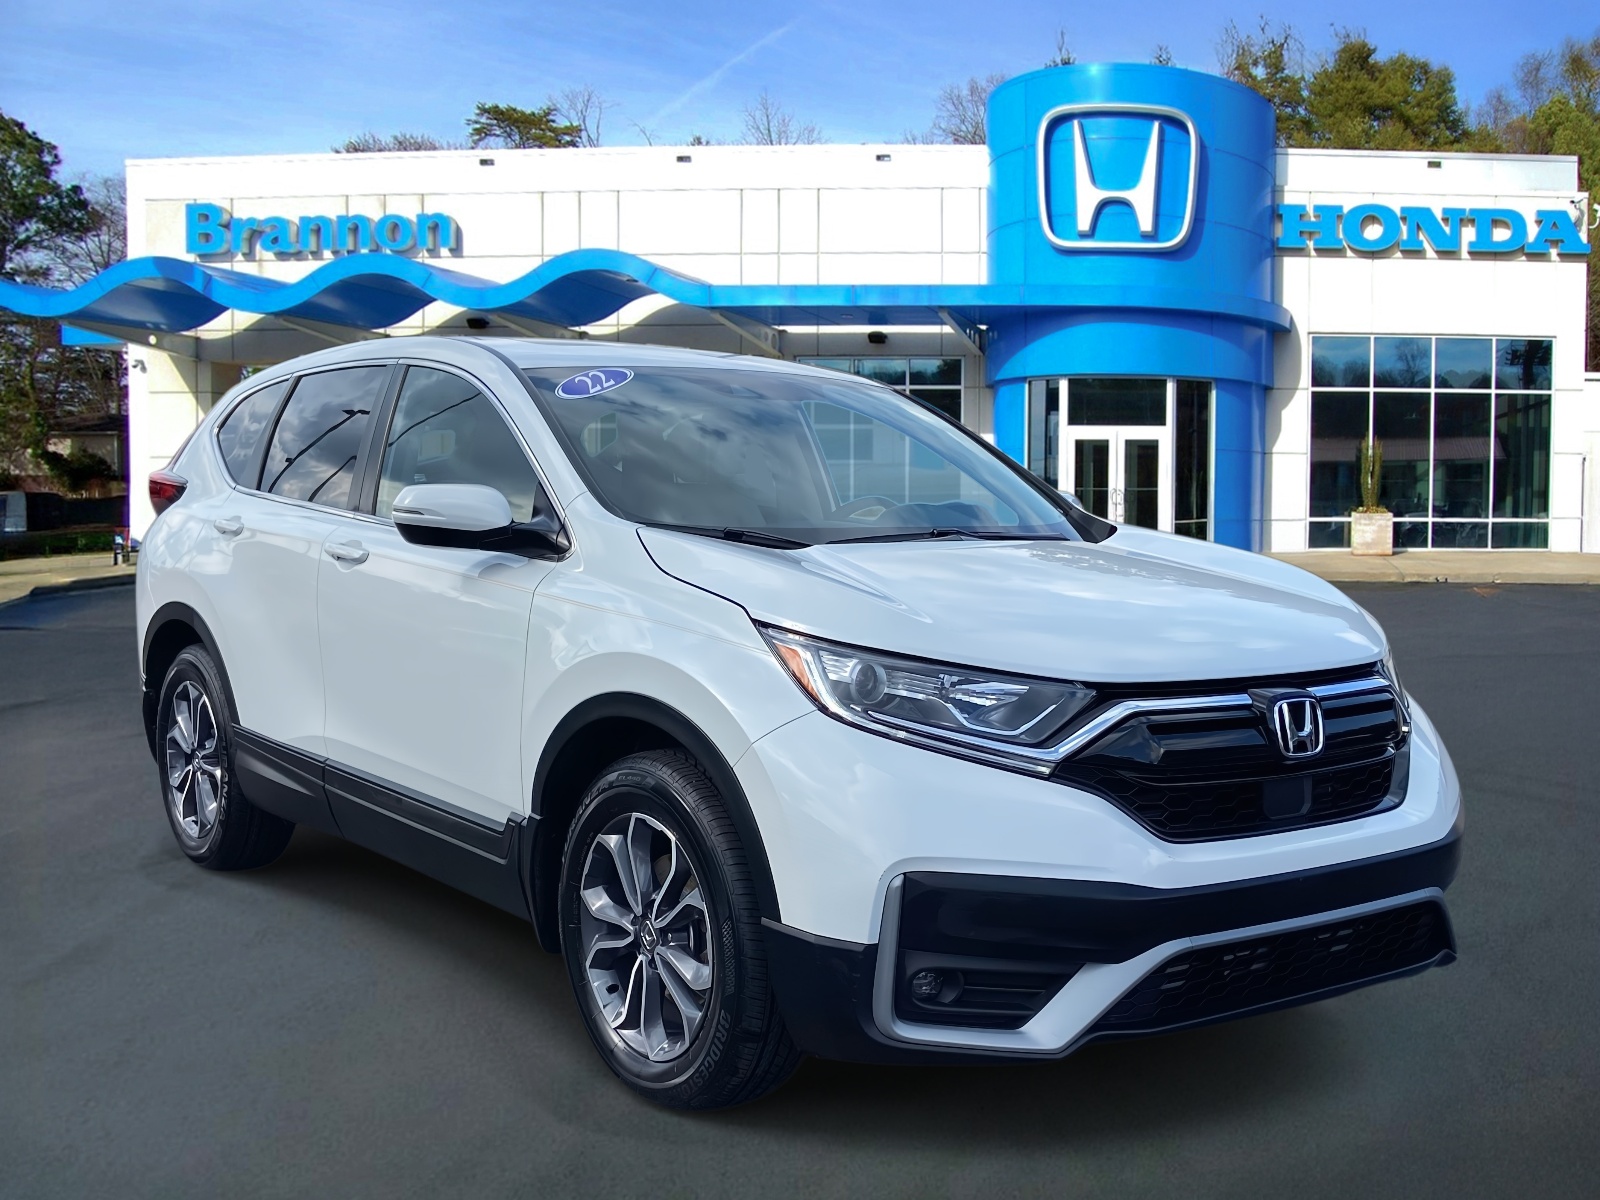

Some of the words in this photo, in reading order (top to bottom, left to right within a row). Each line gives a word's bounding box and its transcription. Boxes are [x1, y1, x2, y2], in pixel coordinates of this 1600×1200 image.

[185, 202, 459, 257] Brannon
[1276, 203, 1592, 254] HONDA
[575, 370, 616, 394] 22
[668, 1009, 731, 1098] BRIDGESTO
